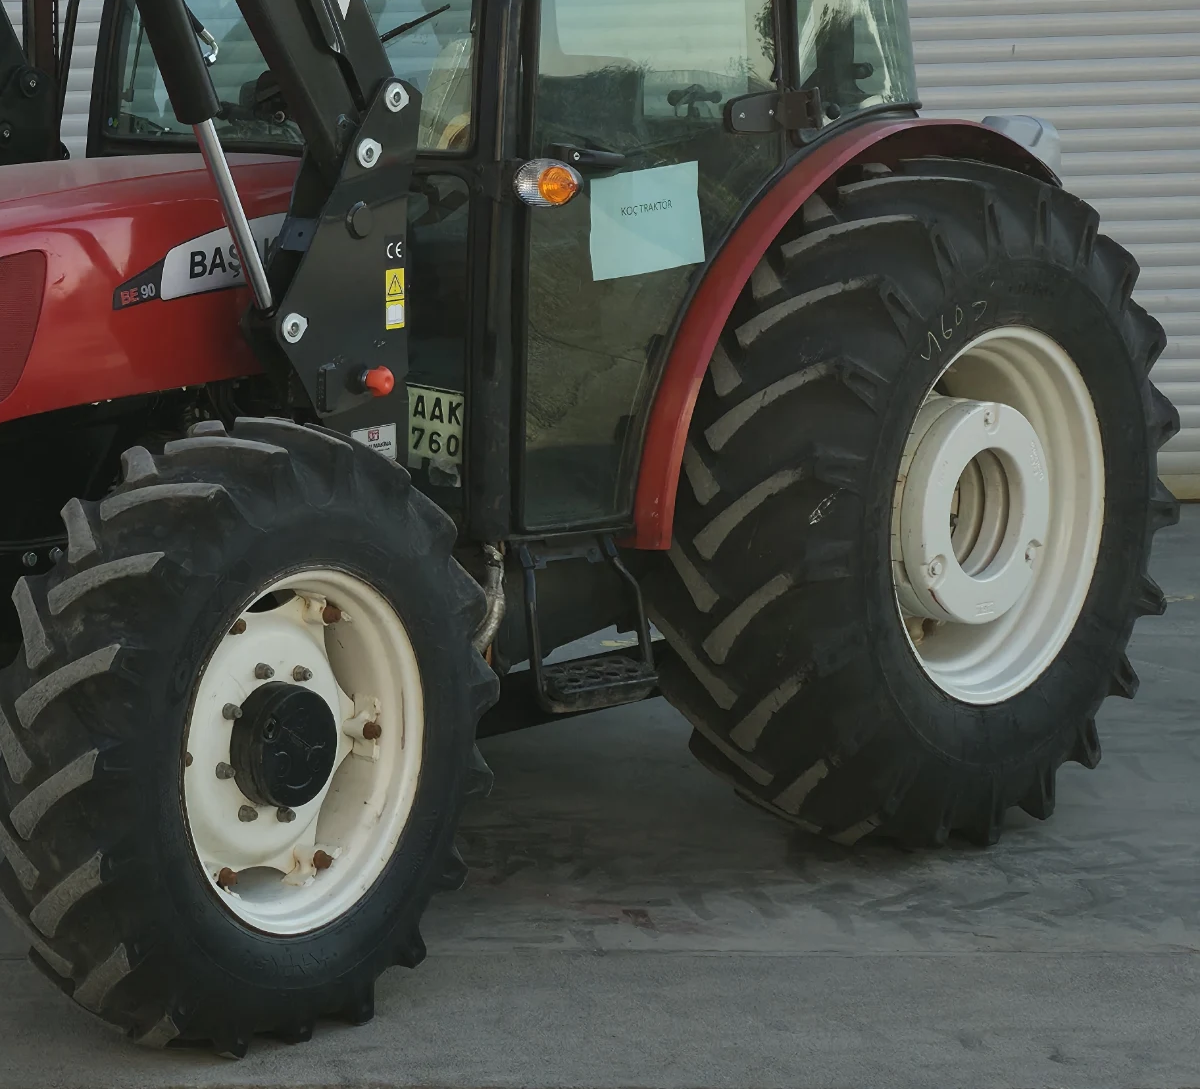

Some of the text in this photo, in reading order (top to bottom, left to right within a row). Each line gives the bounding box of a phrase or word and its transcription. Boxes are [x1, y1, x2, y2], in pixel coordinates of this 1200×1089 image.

[620, 199, 673, 216] KOÇ TRAKTÖR
[386, 241, 403, 259] CE
[120, 283, 156, 306] BE 90
[412, 394, 463, 427] AAK
[411, 426, 460, 457] 760
